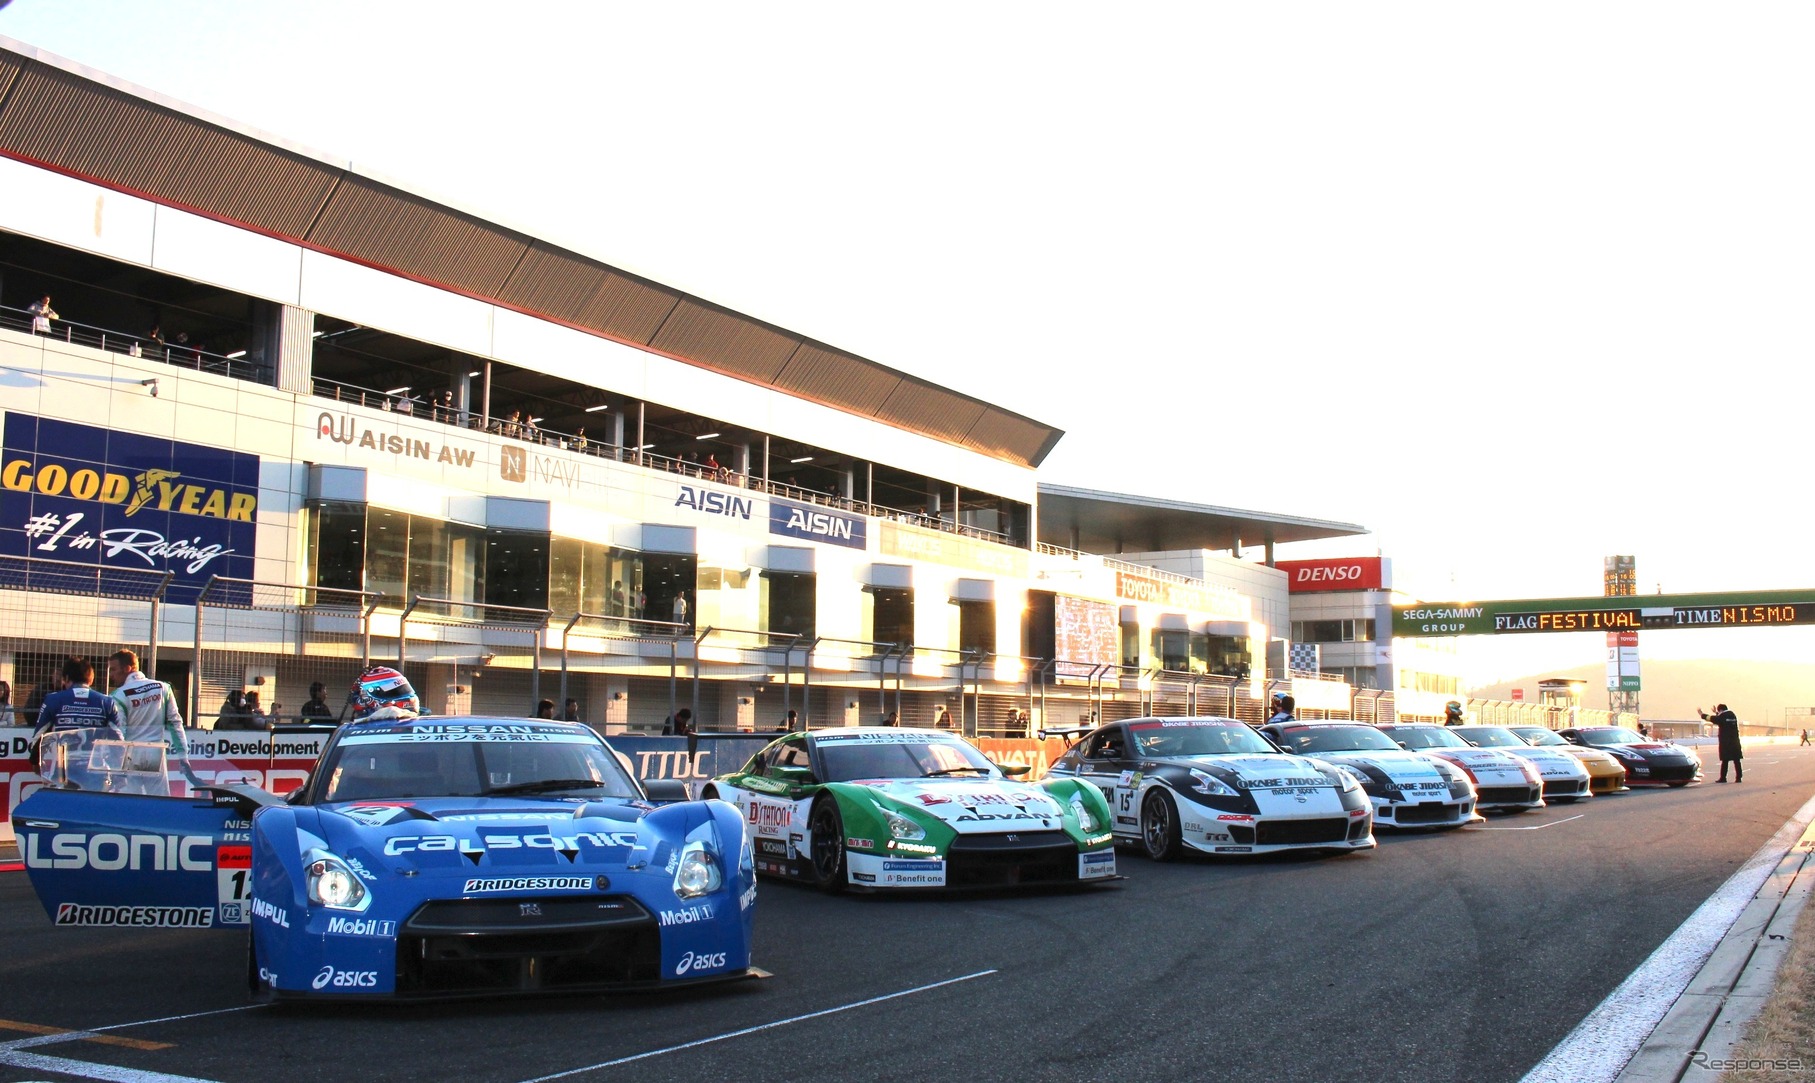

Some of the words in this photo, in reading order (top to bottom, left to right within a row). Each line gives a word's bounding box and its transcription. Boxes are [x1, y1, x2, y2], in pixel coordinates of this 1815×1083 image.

[359, 429, 430, 460] AISIN
[437, 445, 475, 468] AW
[675, 486, 752, 520] AISIN
[786, 508, 852, 540] AISIN
[24, 512, 84, 551] #1
[69, 530, 96, 549] in
[101, 528, 235, 574] Racing
[1297, 565, 1362, 582] DENSO
[1121, 577, 1158, 599] TOYOTA
[1403, 609, 1434, 620] SEGA
[1437, 607, 1484, 619] SAMMY
[1540, 612, 1641, 629] FESTIVAL
[1674, 608, 1721, 624] TIME
[1422, 623, 1466, 632] GROUP
[1494, 616, 1538, 630] FLAG
[412, 725, 532, 734] NISSAN
[218, 739, 319, 758] Development
[636, 750, 711, 780] TTDC
[1237, 778, 1283, 789] OKABE
[1385, 782, 1418, 791] OKABE
[1271, 788, 1295, 796] motor
[1296, 788, 1320, 796] sport
[1120, 793, 1130, 812] 15
[443, 813, 568, 822] NISSAN
[956, 813, 1052, 822] ADVAN
[758, 825, 779, 835] RACING
[464, 877, 592, 893] BRIDGESTONE
[896, 874, 926, 883] Benefit
[56, 903, 214, 927] BRIDGESTONE
[225, 906, 238, 918] ZF
[252, 896, 290, 928] IMPUL
[660, 906, 701, 927] Mobil
[327, 917, 377, 935] Mobil
